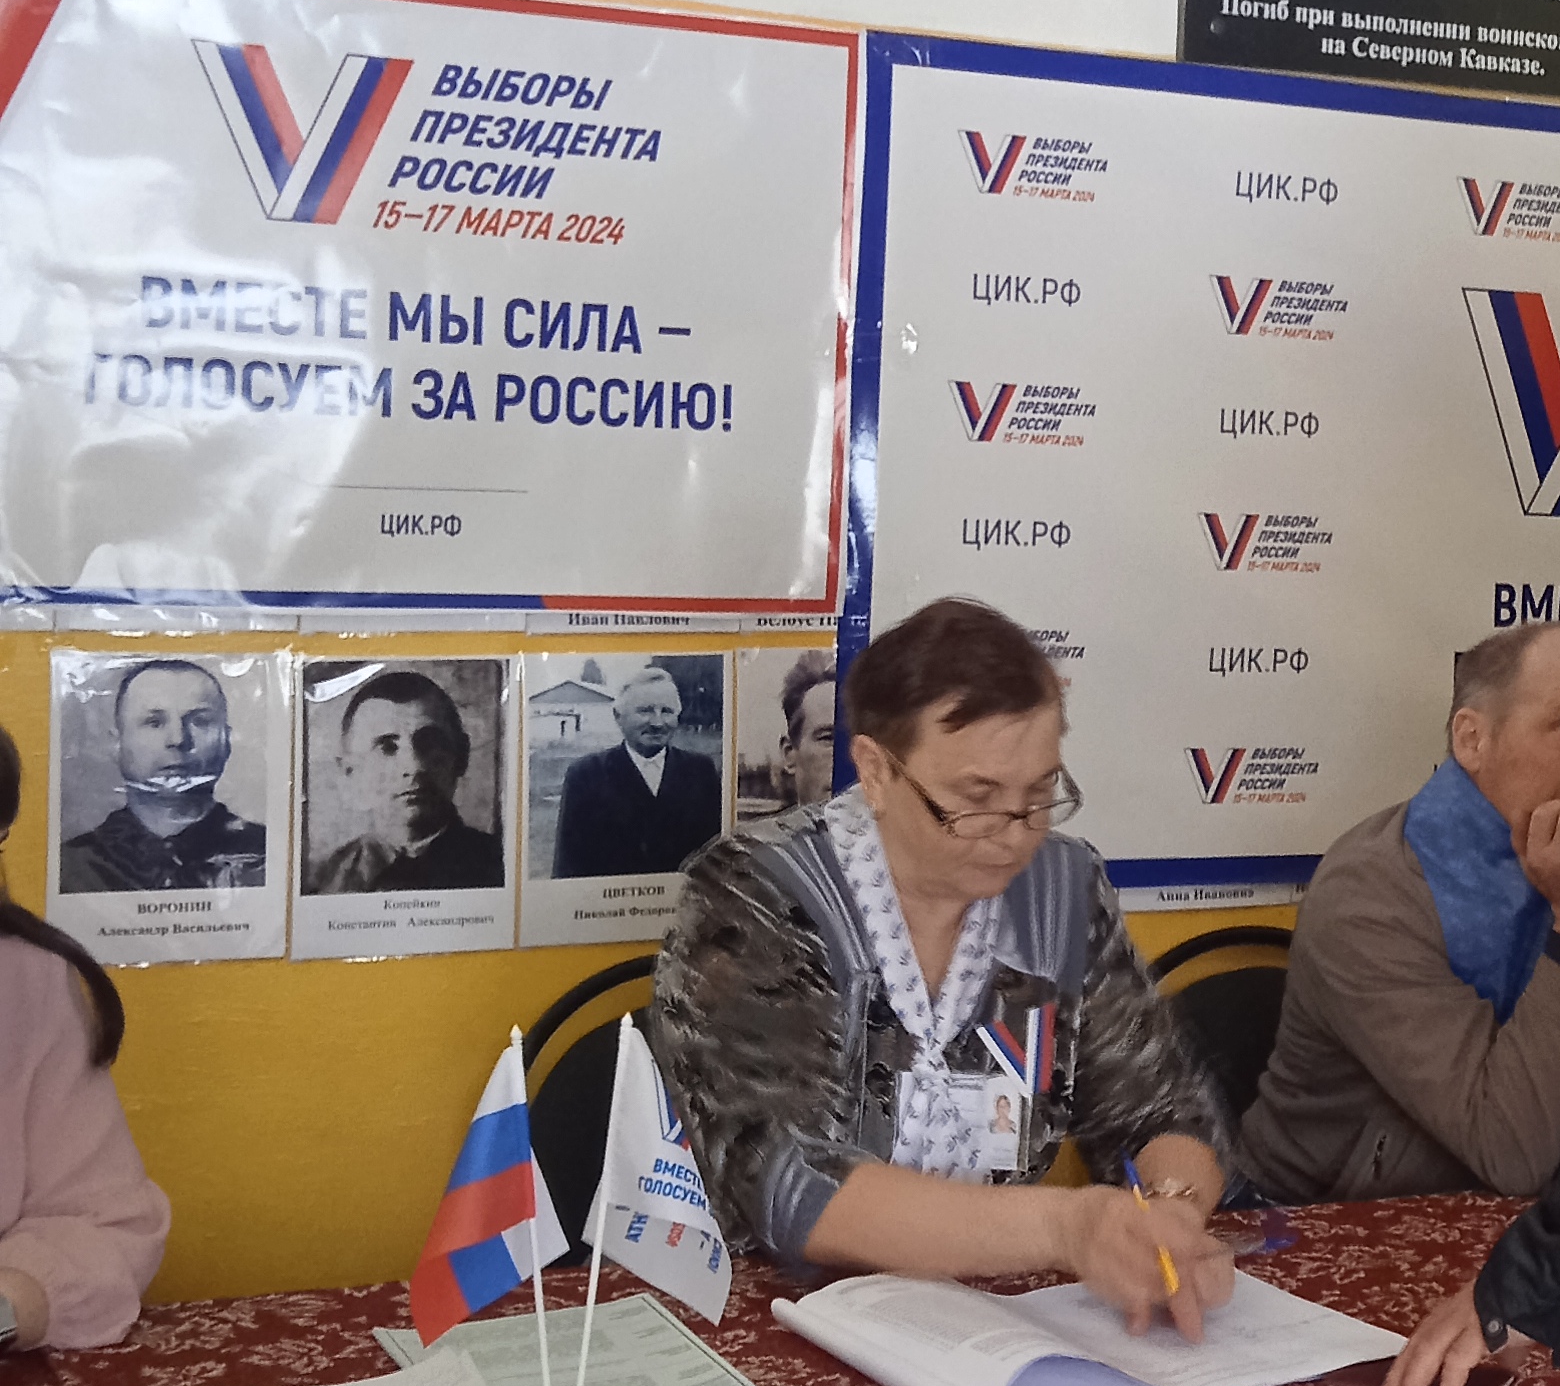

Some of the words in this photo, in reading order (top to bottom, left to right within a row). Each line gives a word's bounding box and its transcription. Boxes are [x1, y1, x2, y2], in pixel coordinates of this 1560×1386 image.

[1294, 6, 1335, 31] при
[1341, 12, 1471, 43] выполнении
[1321, 37, 1347, 57] на
[1351, 35, 1454, 71] Северном
[1459, 49, 1546, 77] Кавказе.
[430, 63, 614, 110] ВЫБОРЫ
[410, 108, 663, 164] ПРЕЗИДЕНТА
[1032, 137, 1093, 154] ВЫБОРЫ
[1025, 153, 1108, 172] ПРЕЗИДЕНТА
[388, 155, 554, 201] РОССИИ
[1018, 169, 1072, 186] РОССИИ
[1235, 171, 1339, 205] ЦИК.РФ
[371, 200, 456, 233] 15–17
[458, 207, 554, 242] МАРТА
[557, 214, 626, 246] 2024
[1507, 213, 1552, 228] РОССИИ
[972, 273, 1081, 307] ЦИК.РФ
[1278, 280, 1334, 296] ВЫБОРЫ
[1270, 296, 1348, 312] ПРЕЗИДЕНТА
[139, 274, 368, 341] ВМЕСТЕ
[387, 291, 484, 347] МЫ
[503, 298, 643, 355] СИЛА
[1263, 311, 1313, 325] РОССИИ
[83, 350, 393, 420] ГОЛОСУЕМ
[411, 368, 477, 421] ЗА
[495, 373, 734, 433] РОССИЮ!
[1023, 384, 1081, 400] ВЫБОРЫ
[1015, 400, 1096, 417] ПРЕЗИДЕНТА
[1008, 416, 1062, 431] РОССИИ
[1219, 409, 1320, 440] ЦИК.РФ
[380, 513, 462, 539] ЦИК.РФ
[1264, 515, 1319, 528] ВЫБОРЫ
[962, 518, 1071, 551] ЦИК.РФ
[1258, 530, 1333, 545] ПРЕЗИДЕНТА
[1251, 545, 1300, 559] РОССИИ
[568, 613, 609, 626] Иван
[614, 614, 690, 626] Павлович
[1209, 647, 1309, 677] ЦИК.РФ
[1251, 747, 1305, 760] ВЫБОРЫ
[1243, 762, 1319, 775] ПРЕЗИДЕНТА
[1237, 778, 1286, 791] РОССИИ
[602, 886, 665, 900] ЦВЕТКОВ
[137, 901, 212, 914] ВОРОНИН
[574, 908, 626, 920] Николай
[97, 926, 170, 937] Александр
[172, 922, 250, 935] Васильевич
[328, 919, 397, 931] Константин
[406, 915, 495, 928] Александрович
[638, 1175, 708, 1211] ГОЛОСУЕМ
